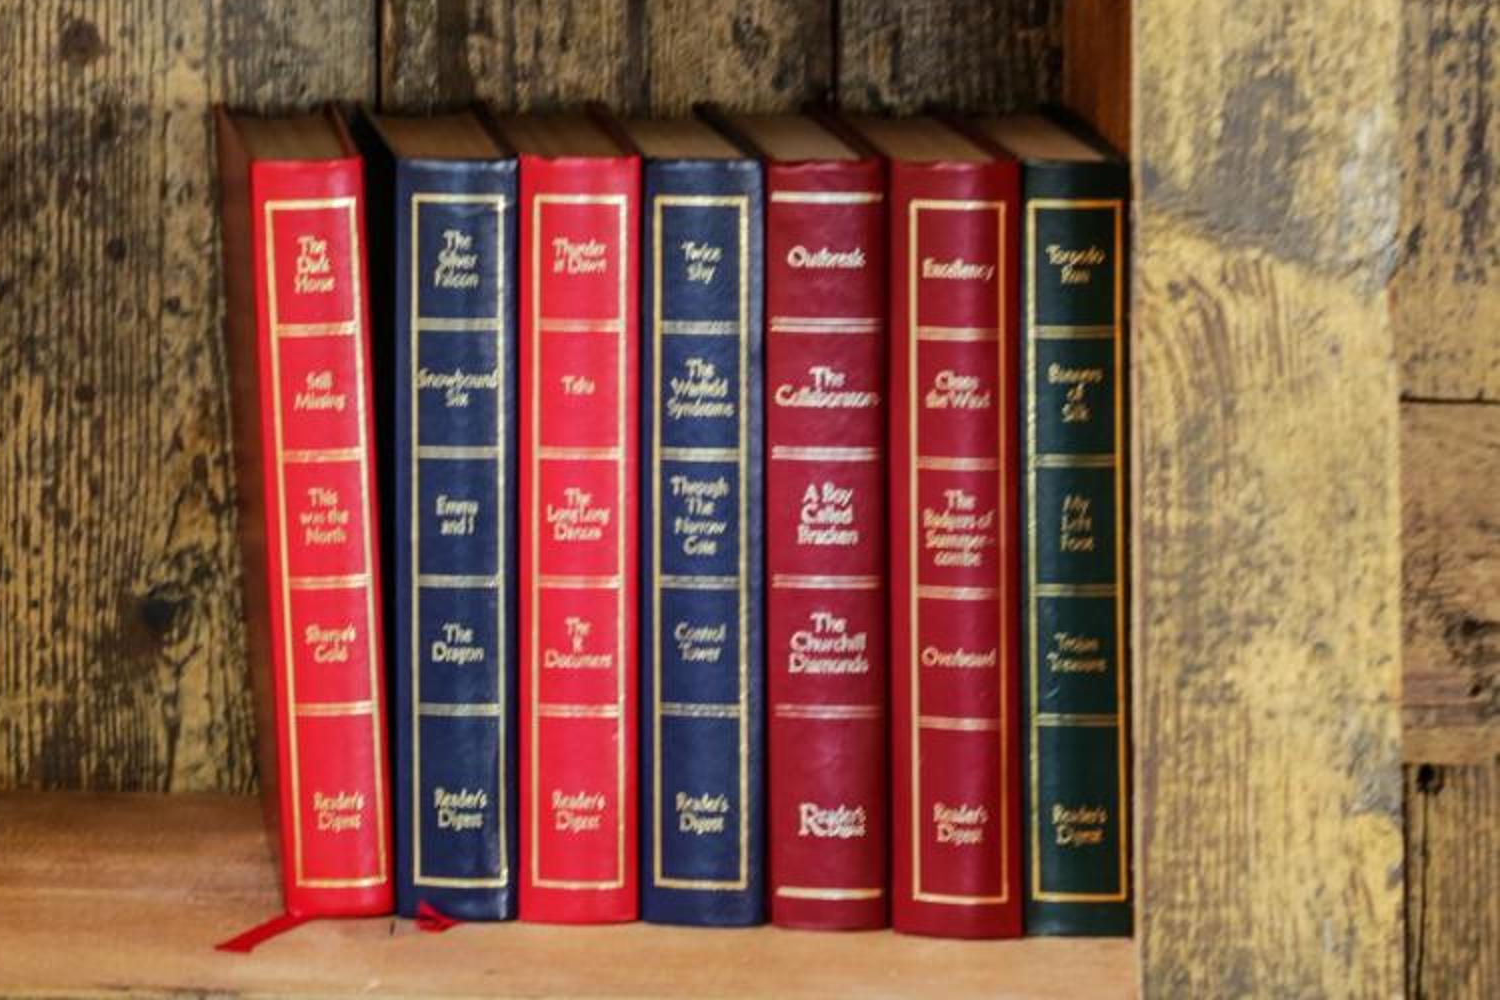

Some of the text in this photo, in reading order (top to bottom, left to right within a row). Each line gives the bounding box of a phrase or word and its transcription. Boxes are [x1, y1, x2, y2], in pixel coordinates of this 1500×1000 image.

[298, 236, 327, 256] The
[443, 229, 472, 250] The
[567, 255, 607, 276] Dawn
[685, 358, 715, 378] The
[808, 364, 846, 388] The
[445, 389, 468, 408] Six
[308, 487, 338, 507] This
[564, 487, 591, 506] The
[670, 475, 729, 498] Through
[803, 481, 853, 506] A Boy
[685, 496, 714, 516] The
[944, 489, 976, 511] The
[801, 502, 853, 526] Called
[304, 526, 347, 547] North
[441, 516, 466, 536] and
[674, 516, 727, 536] Narrow
[564, 617, 591, 636] The
[809, 611, 847, 633] The
[442, 623, 474, 644] The
[790, 630, 867, 653] Churchill
[431, 642, 485, 666] Dragon
[788, 652, 869, 674] Diamonds
[313, 791, 365, 812] Reader's
[434, 786, 488, 809] Reader's
[552, 789, 606, 810] Reader's
[675, 791, 730, 813] Reader's
[437, 809, 484, 831] Digest
[555, 809, 601, 833] Digest
[679, 812, 724, 835] Digest
[933, 801, 988, 825] Reader's
